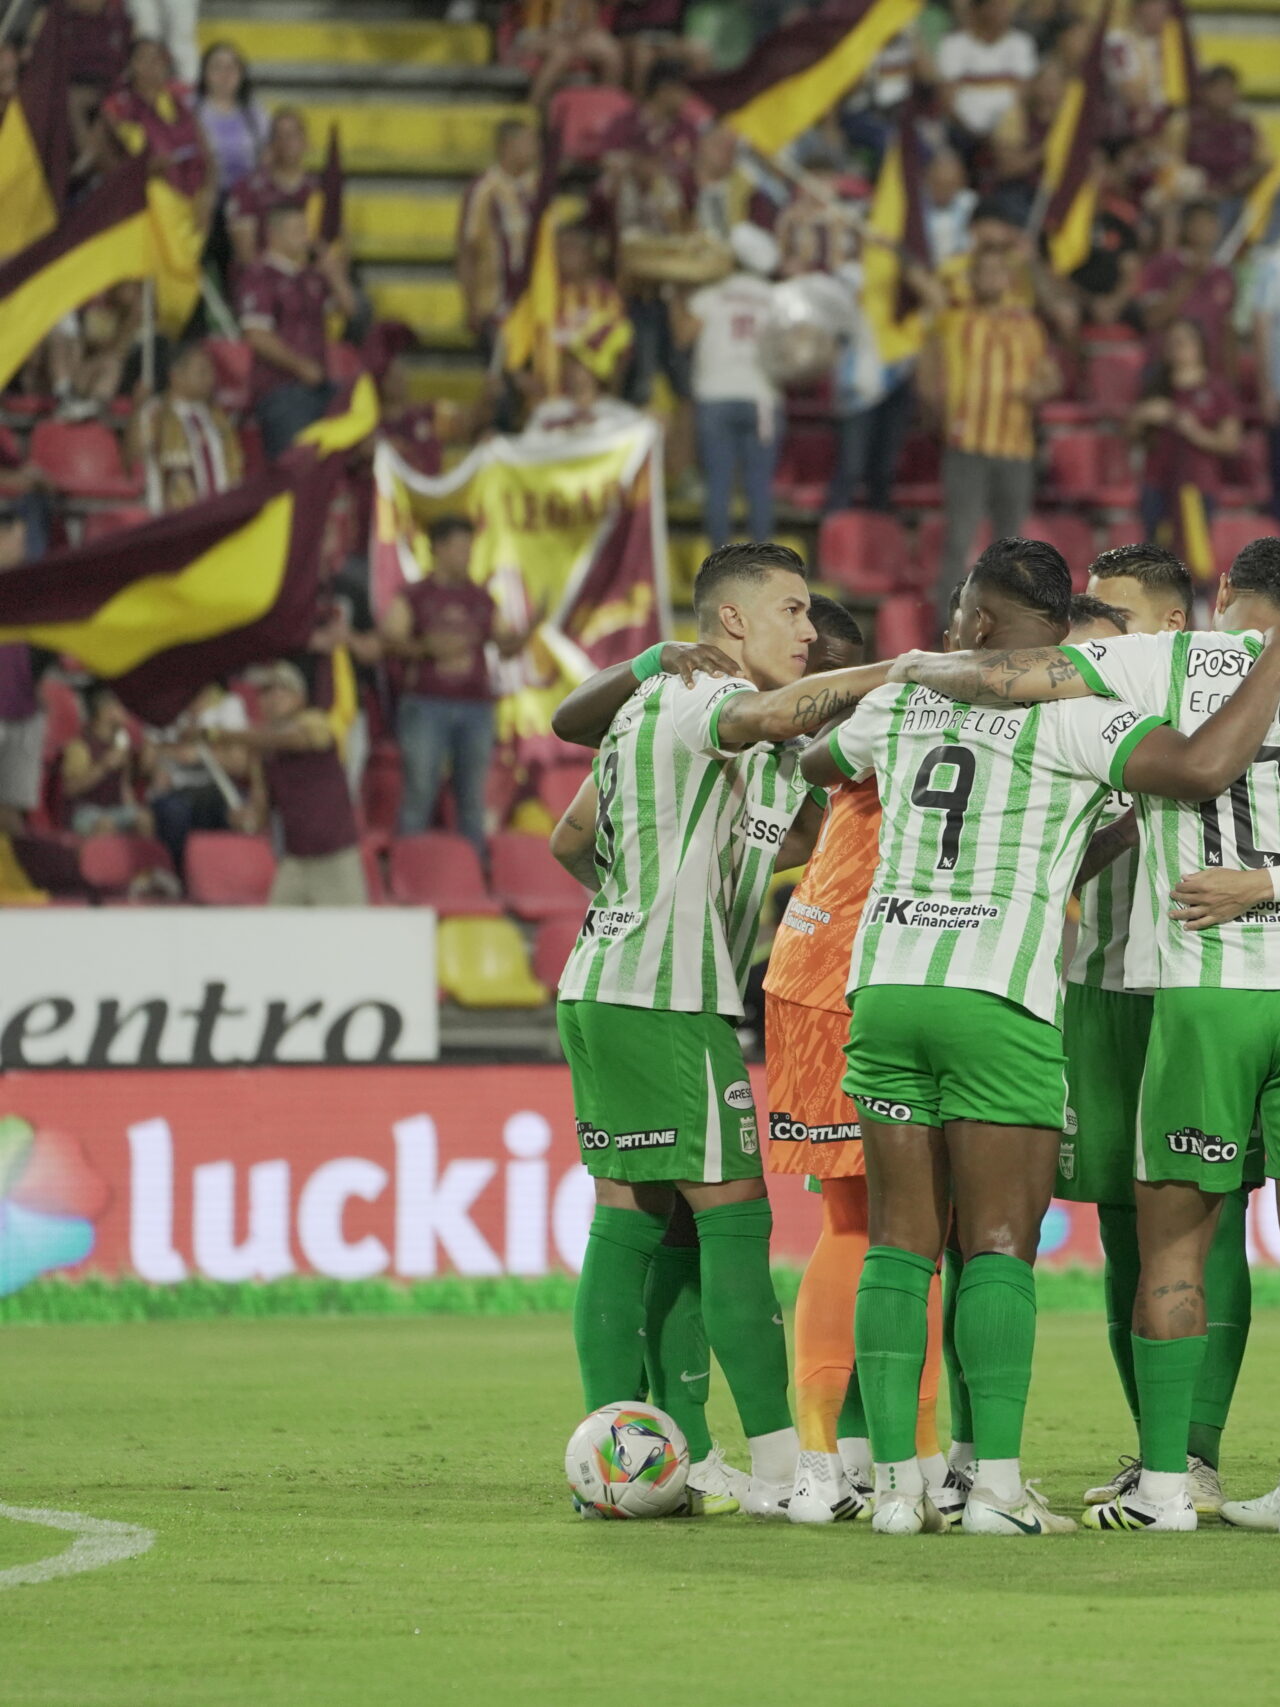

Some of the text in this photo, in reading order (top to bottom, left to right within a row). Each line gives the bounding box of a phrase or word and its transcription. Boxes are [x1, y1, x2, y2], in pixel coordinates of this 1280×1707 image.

[911, 745, 976, 870] 9
[915, 901, 998, 917] Cooperativa
[909, 914, 980, 928] Financiera
[614, 1130, 675, 1148] ORTLINE
[808, 1124, 861, 1140] RTLINE
